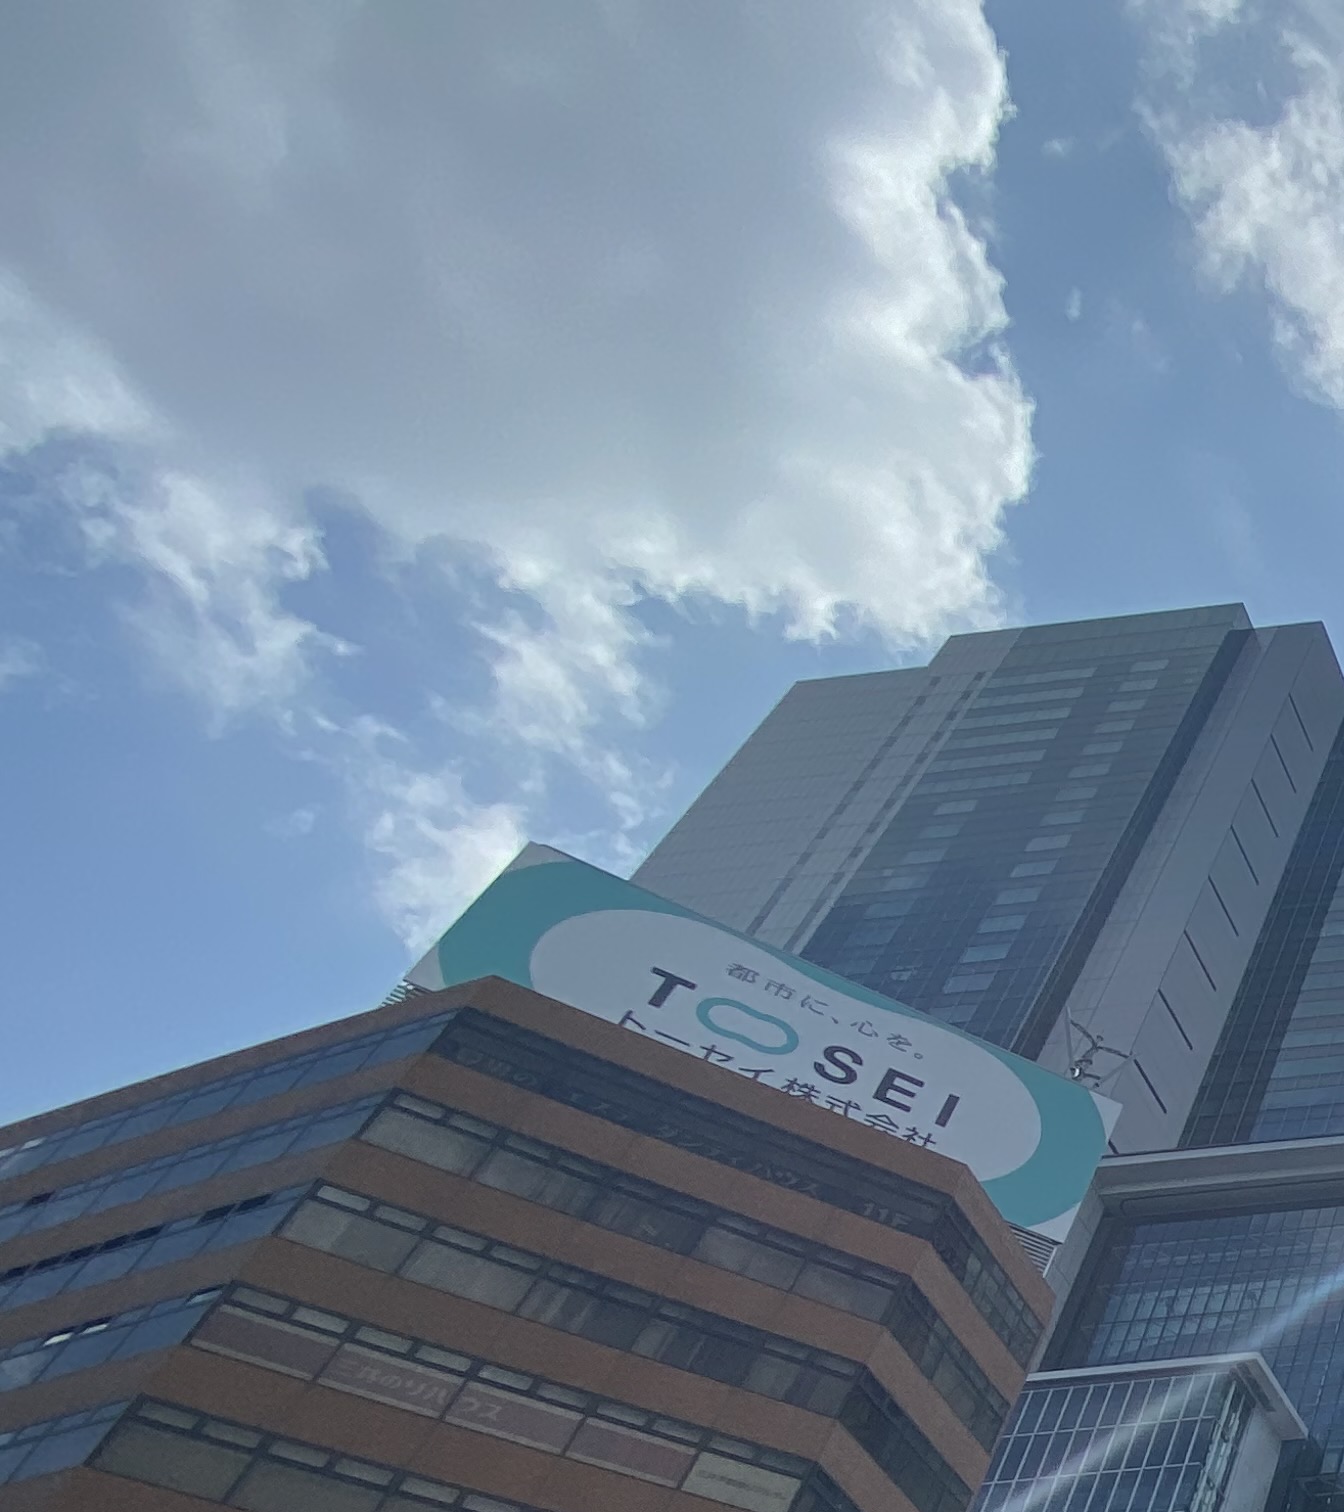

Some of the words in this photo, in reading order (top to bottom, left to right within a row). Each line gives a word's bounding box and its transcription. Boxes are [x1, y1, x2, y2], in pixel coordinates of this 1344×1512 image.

[647, 966, 961, 1129] TOSEI
[724, 962, 924, 1060] 都市に、心を。
